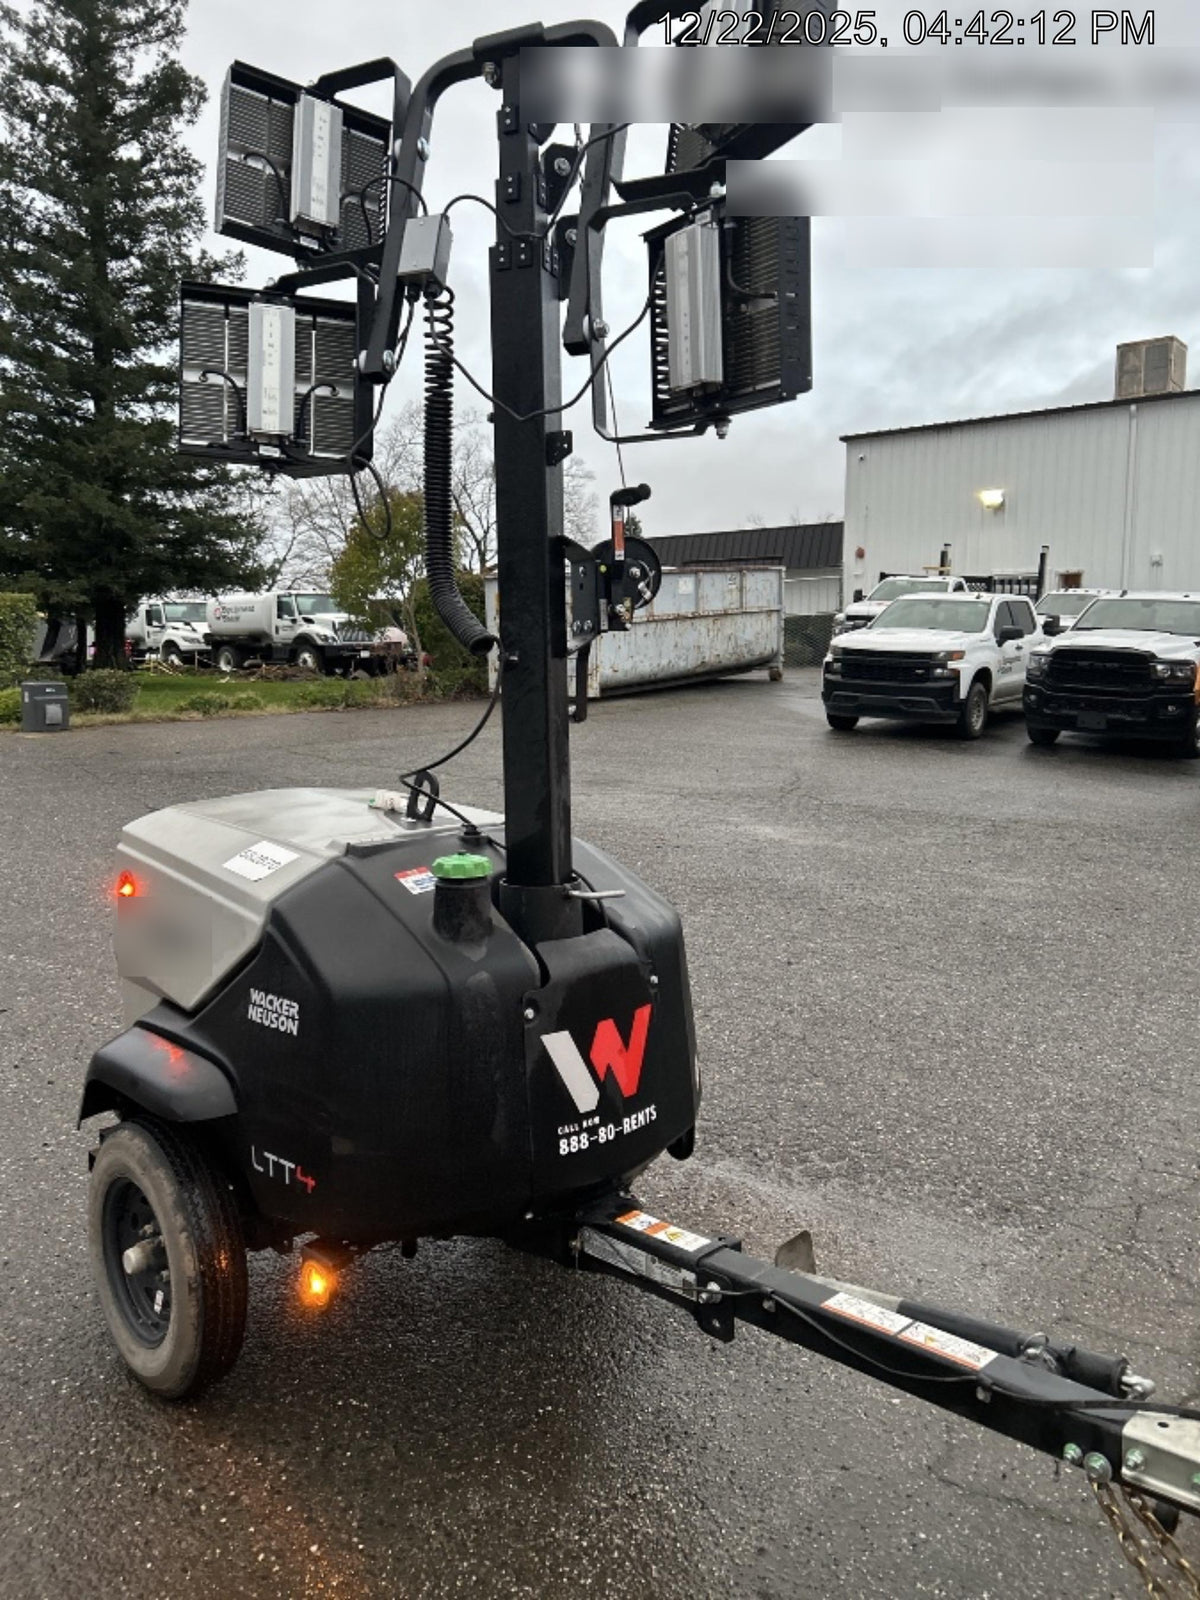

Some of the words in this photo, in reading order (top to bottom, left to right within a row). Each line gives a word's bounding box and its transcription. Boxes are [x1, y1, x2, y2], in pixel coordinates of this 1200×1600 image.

[248, 1003, 299, 1037] NEUSON
[249, 987, 300, 1020] WACKER
[559, 1103, 657, 1156] 888-80-RENTS
[251, 1145, 316, 1194] LTT4
